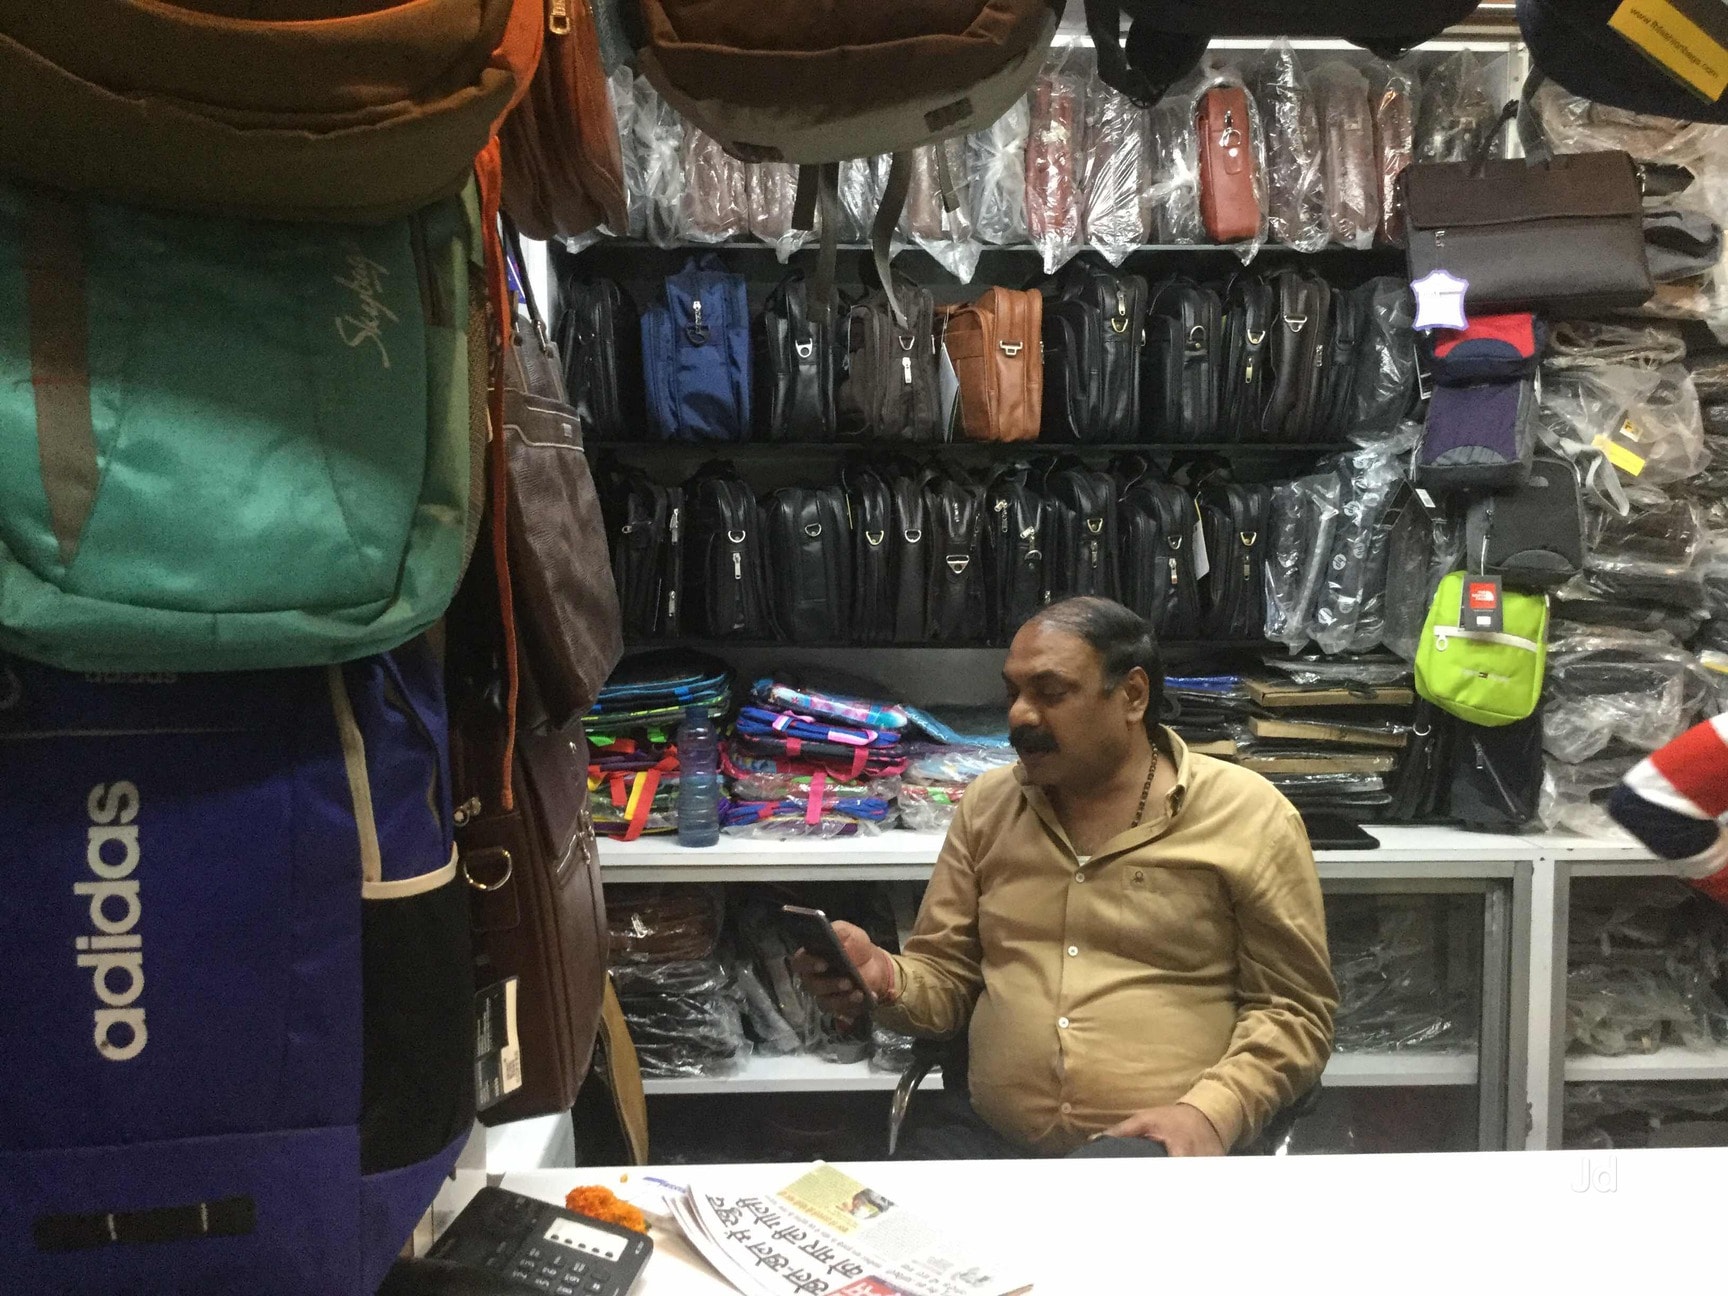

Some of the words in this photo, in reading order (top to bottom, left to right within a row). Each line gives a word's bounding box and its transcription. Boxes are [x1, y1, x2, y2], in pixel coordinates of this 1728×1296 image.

[73, 780, 147, 1060] adidas
[705, 1194, 743, 1228] खुद
[736, 1197, 780, 1229] गोली
[771, 1225, 807, 1245] ली
[798, 1240, 835, 1264] मार
[827, 1258, 863, 1279] को
